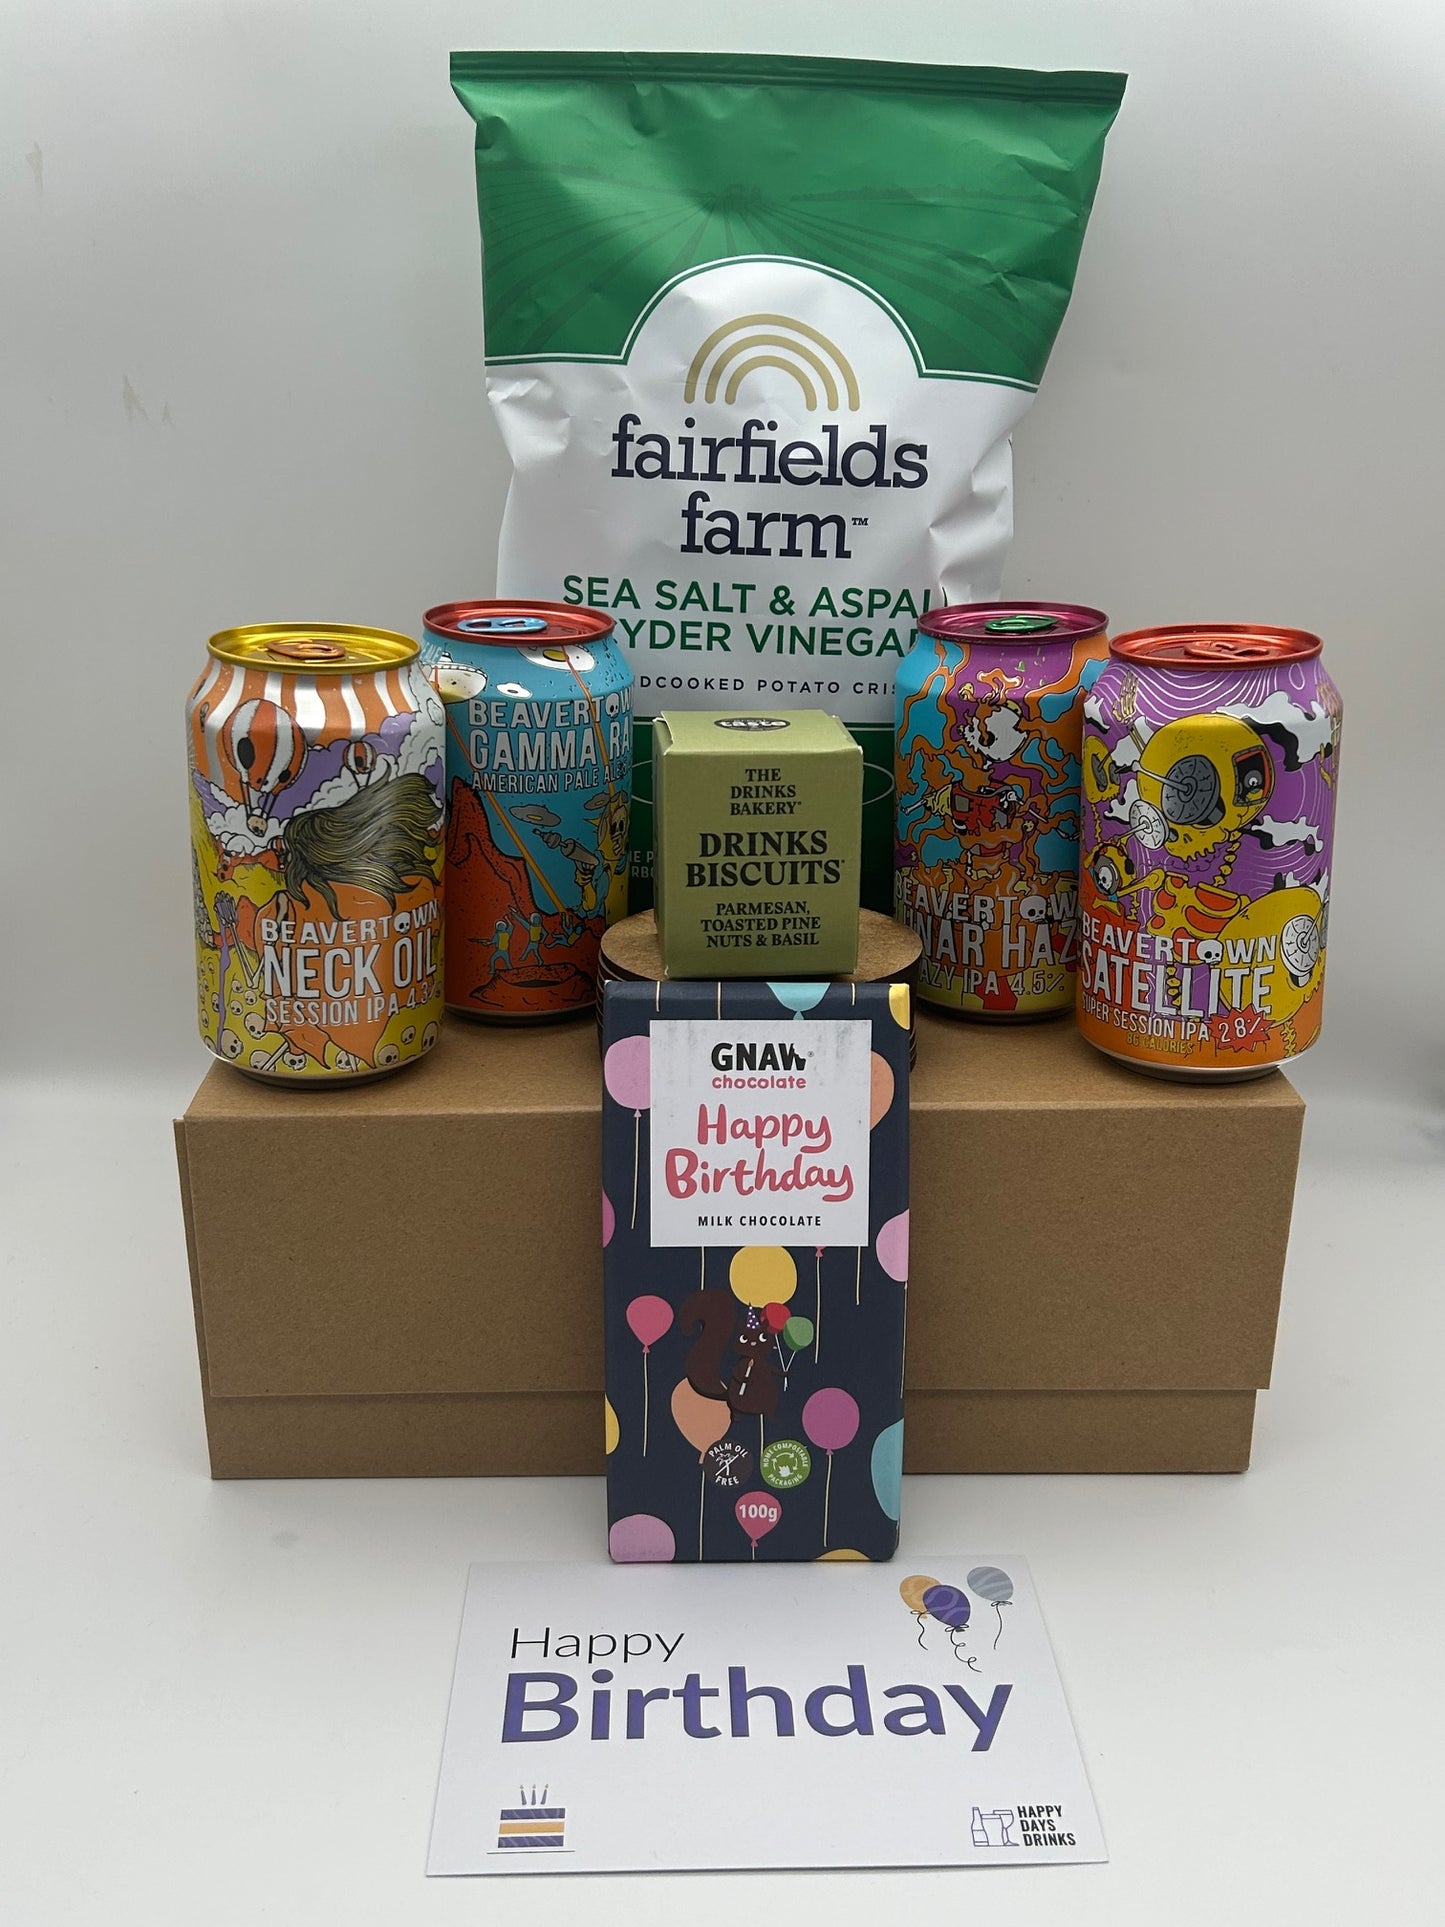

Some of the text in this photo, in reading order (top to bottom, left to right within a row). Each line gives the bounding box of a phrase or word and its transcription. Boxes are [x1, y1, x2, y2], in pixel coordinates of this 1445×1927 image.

[611, 412, 929, 489] fairfields
[680, 490, 852, 559] farm
[562, 574, 641, 610] SEA
[655, 579, 757, 615] SALT
[768, 585, 796, 616] &
[619, 617, 732, 652] YDER
[640, 675, 745, 692] DCOOKED
[758, 679, 841, 695] POTATO
[469, 728, 598, 771] GAMMA
[609, 715, 630, 761] RA
[472, 771, 559, 793] AMERICAN
[564, 768, 599, 790] PALE
[745, 768, 782, 782] THE
[730, 785, 797, 799] DRINKS
[730, 801, 799, 816] BAKERY
[699, 830, 828, 858] DRINKS
[686, 859, 841, 888] BISCUITS
[261, 898, 439, 945] BEAVERTOWN
[716, 901, 810, 916] PARMESAN,
[701, 916, 821, 932] TOASTED PINE
[1081, 910, 1277, 965] BEAVERTOWN
[706, 933, 820, 948] NUTS & BASIL
[1002, 918, 1077, 969] HAZ
[263, 927, 437, 999] NECK OIL
[920, 957, 1065, 996] AZY IPA 4.5%
[1081, 939, 1275, 1017] SATELLITE
[265, 998, 360, 1026] SESSION
[367, 992, 400, 1023] IPA
[1081, 990, 1265, 1043] SUPER SESSION IPA 2.8%
[711, 1042, 807, 1072] GNAW
[1143, 1035, 1194, 1055] CALORIES
[711, 1074, 807, 1090] chocolate
[697, 1103, 832, 1154] Happy
[665, 1147, 854, 1203] Birthday
[698, 1215, 822, 1227] MILK CHOCOLATE
[708, 1442, 749, 1459] PALM OIL
[773, 1442, 809, 1467] COMPOSTABLE
[715, 1475, 740, 1486] FREE
[767, 1473, 803, 1486] PACKAGING
[739, 1503, 778, 1523] 100g
[510, 1626, 686, 1664] Happy
[501, 1664, 1014, 1753] Birthday
[1017, 1804, 1063, 1818] HAPPY
[1020, 1818, 1057, 1832] DAYS
[1023, 1833, 1077, 1847] DRINKS
